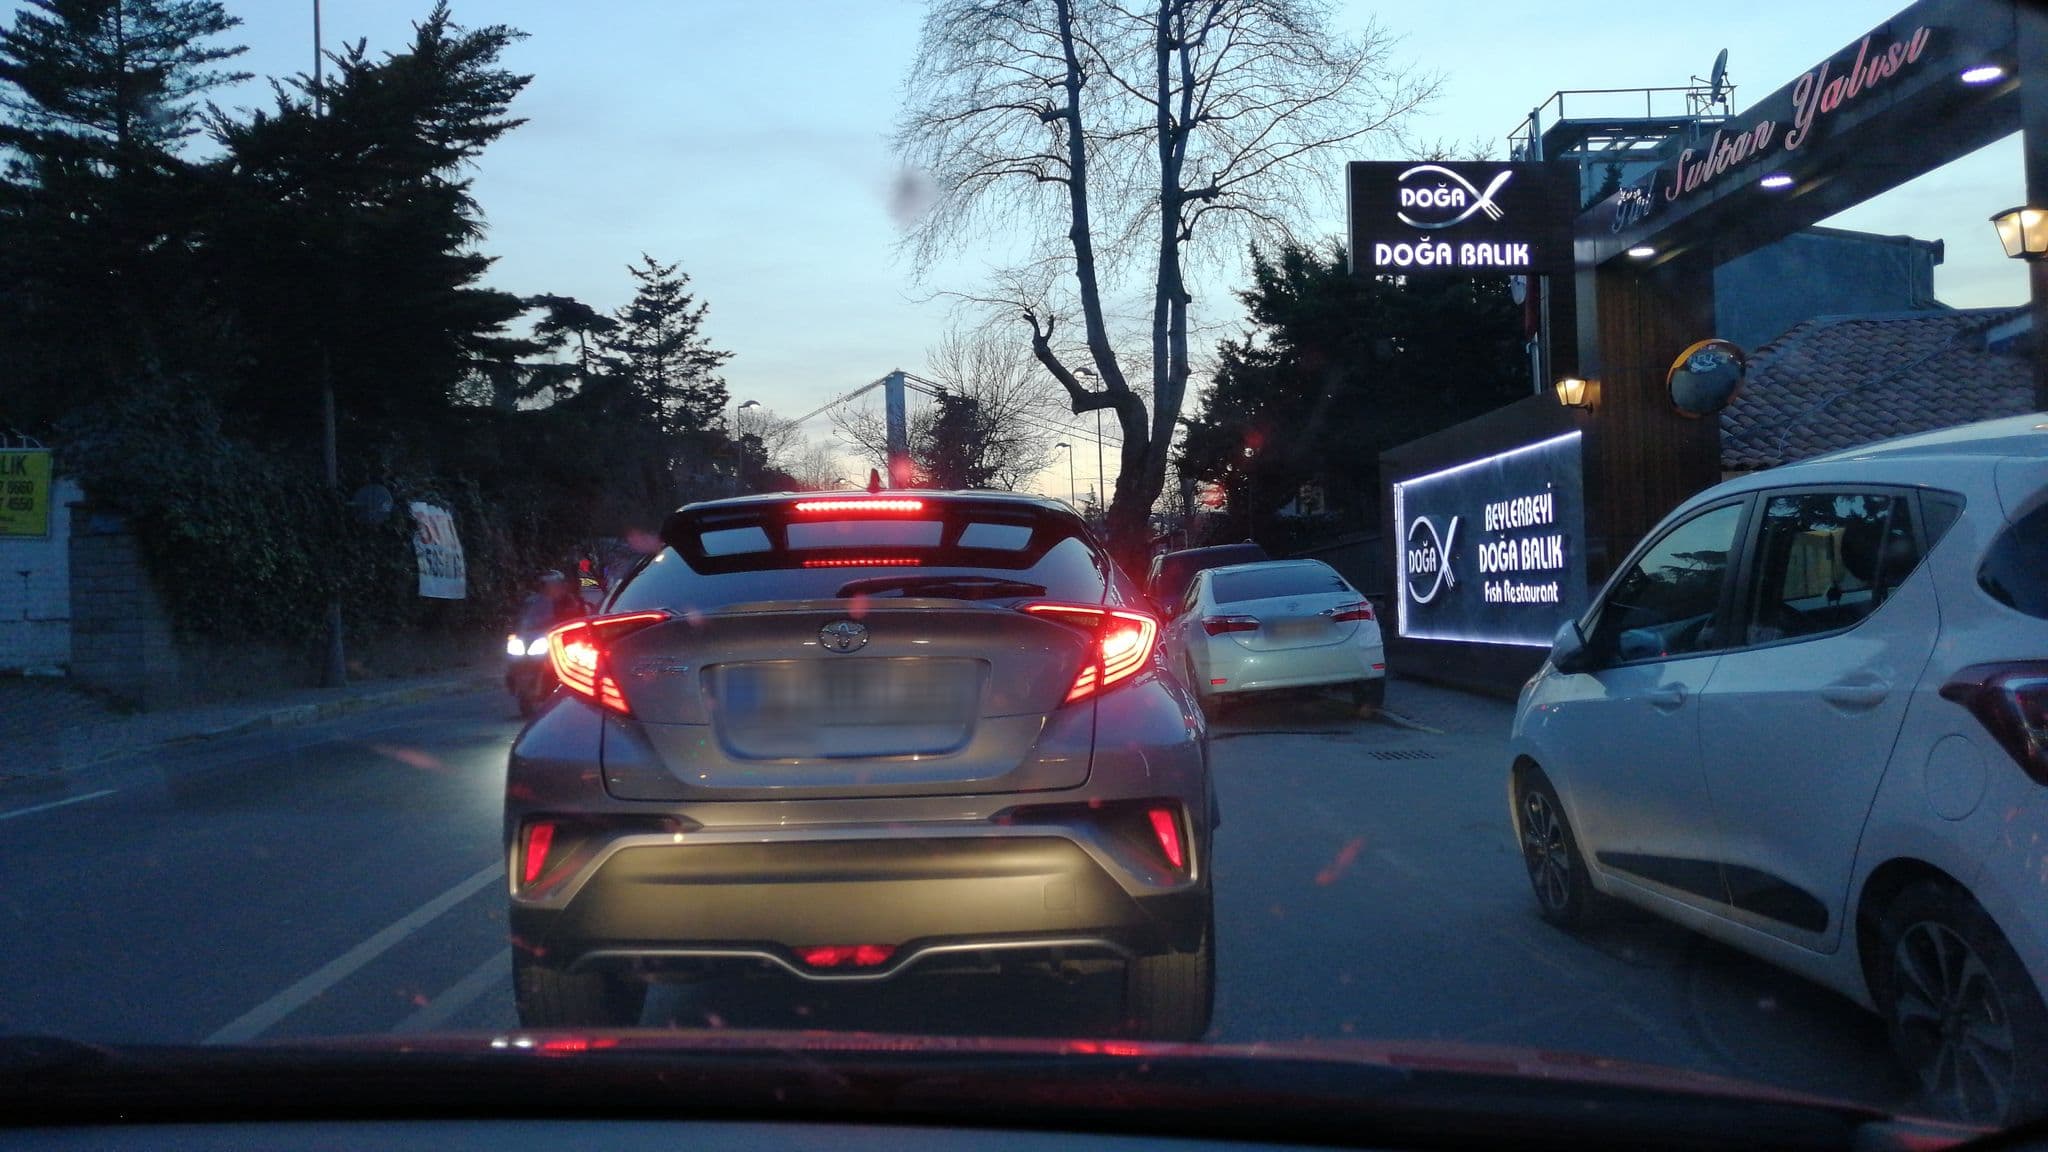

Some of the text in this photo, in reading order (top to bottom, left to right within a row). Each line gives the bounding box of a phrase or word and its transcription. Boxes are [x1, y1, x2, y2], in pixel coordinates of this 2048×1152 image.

[1665, 120, 1776, 201] Sultan
[1400, 182, 1466, 208] DOĞA
[1375, 235, 1529, 267] DOĞA BALIK
[1485, 482, 1553, 532] BEYLERBEYİ
[1408, 540, 1437, 574] DOĞA
[1478, 534, 1563, 573] DOĞA BALIK
[1503, 579, 1559, 603] Restaurant
